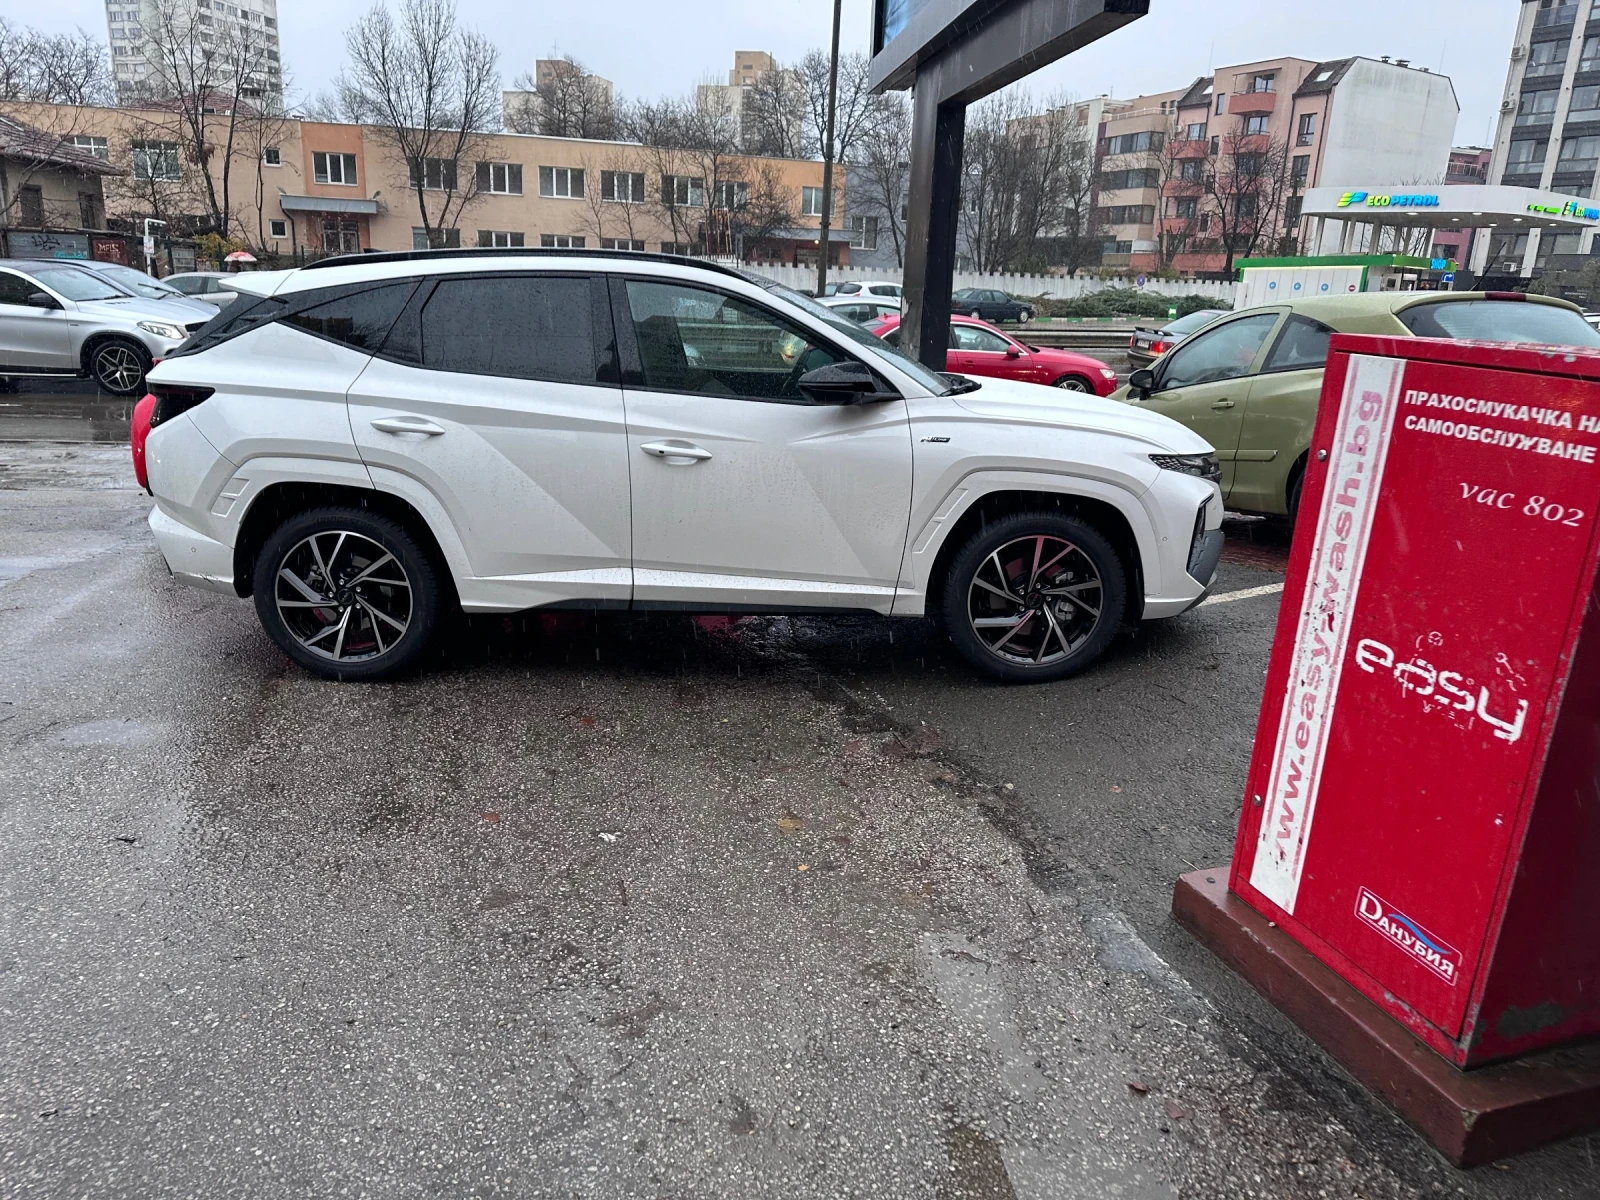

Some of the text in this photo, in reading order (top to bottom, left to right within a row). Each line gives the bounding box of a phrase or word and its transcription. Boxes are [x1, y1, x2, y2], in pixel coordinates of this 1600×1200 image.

[1366, 195, 1439, 207] ECOPETROL
[1404, 390, 1572, 429] ПРАХОСМУКАЧКА
[1404, 415, 1598, 464] САМООБСЛУЖВАНЕ
[1459, 482, 1585, 527] vac 802
[1355, 638, 1529, 742] easy
